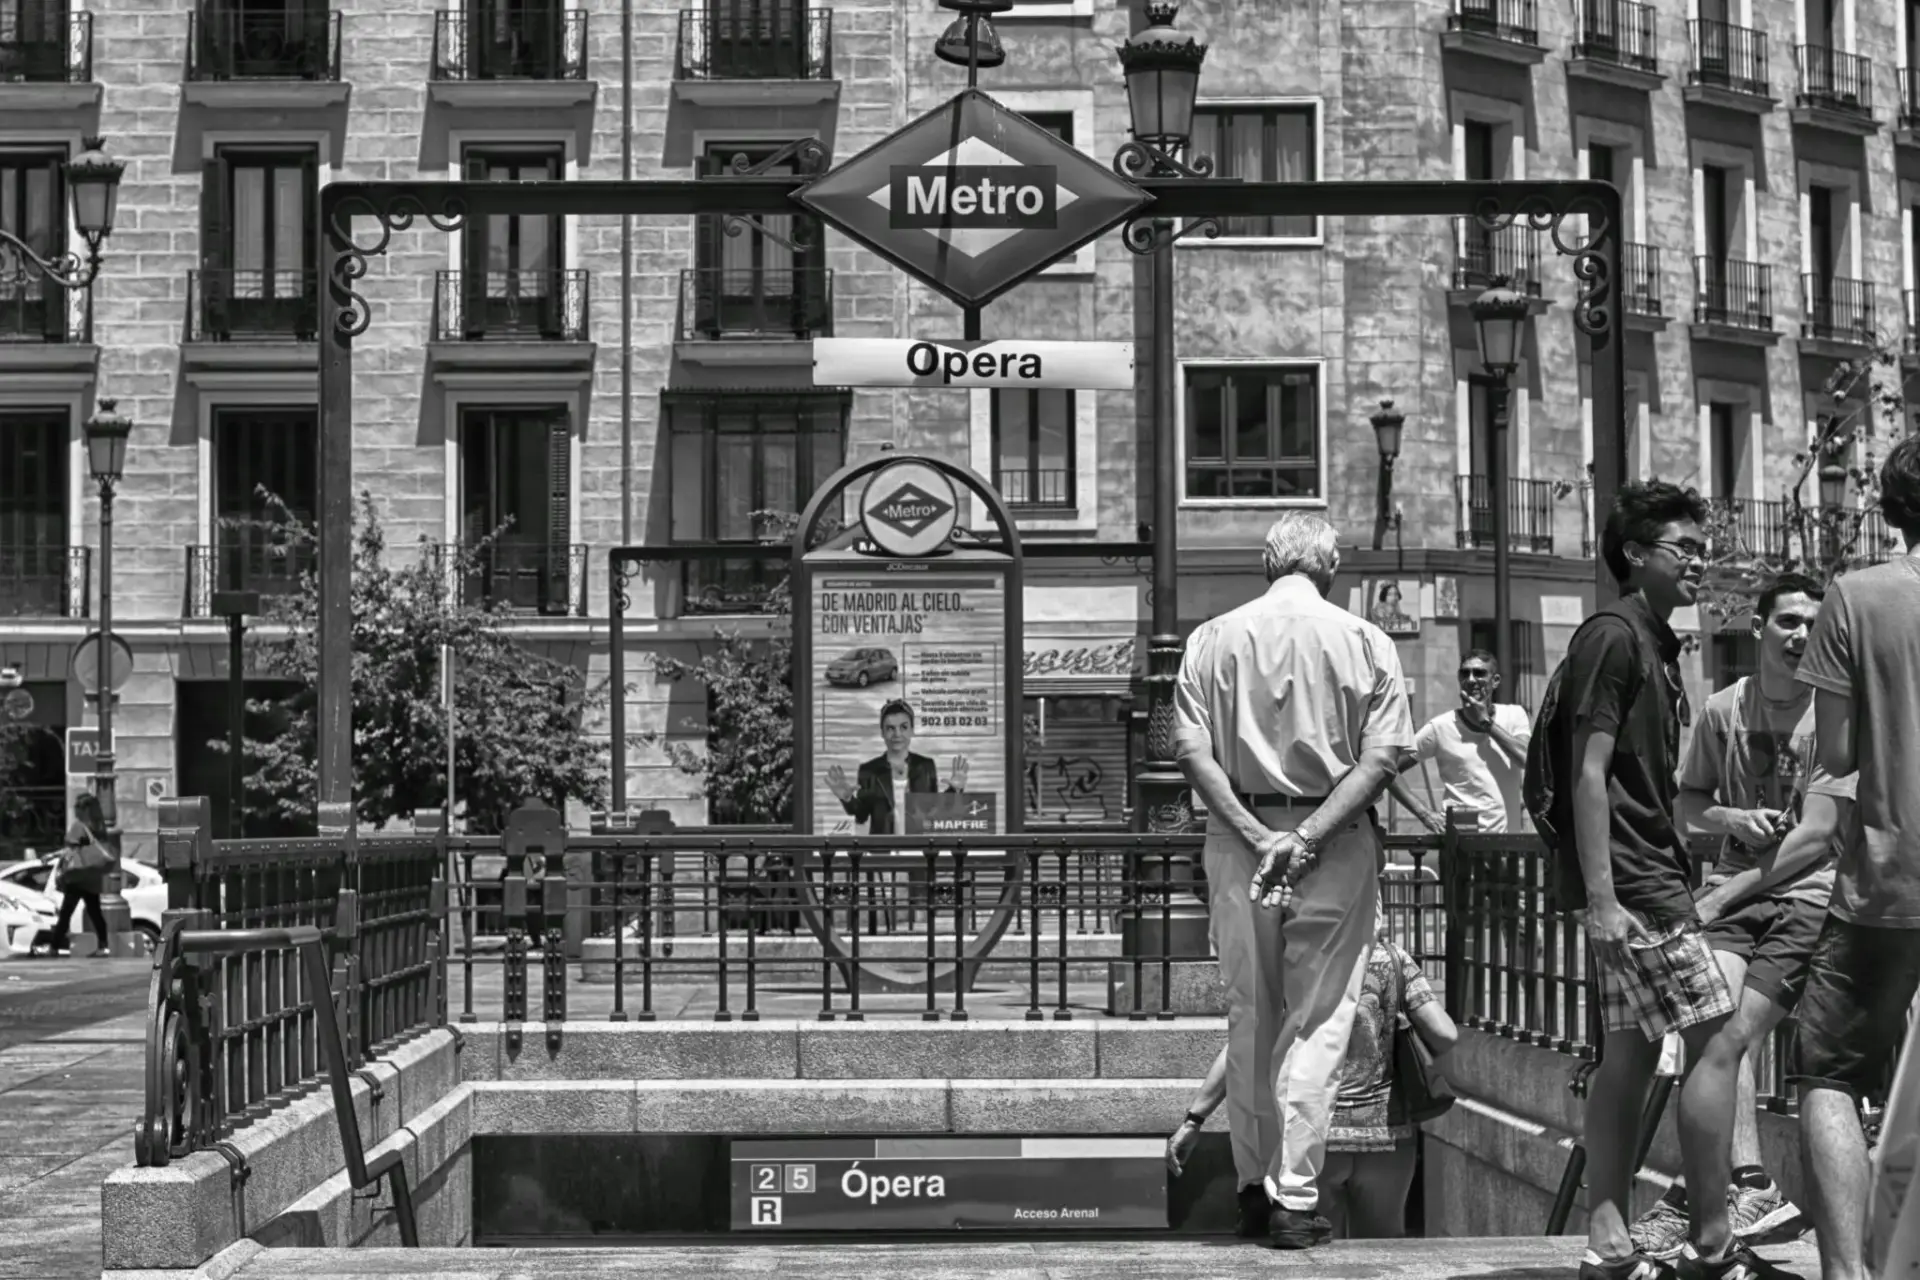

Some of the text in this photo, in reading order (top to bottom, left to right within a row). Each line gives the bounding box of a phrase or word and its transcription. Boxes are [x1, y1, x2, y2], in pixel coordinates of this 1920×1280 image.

[906, 175, 1044, 216] Metro
[906, 341, 1042, 385] Opera
[889, 504, 931, 519] Metro
[822, 592, 839, 612] DE
[844, 592, 897, 612] MADRID
[902, 592, 917, 612] AL
[822, 614, 848, 634] CON
[921, 716, 988, 726] 902 03 02 03
[71, 741, 99, 756] TAX
[933, 820, 988, 829] MAPFRE
[758, 1168, 809, 1190] 2 5
[841, 1161, 945, 1204] Ópera
[758, 1200, 776, 1222] R
[1014, 1207, 1099, 1219] Acceso Arenal
